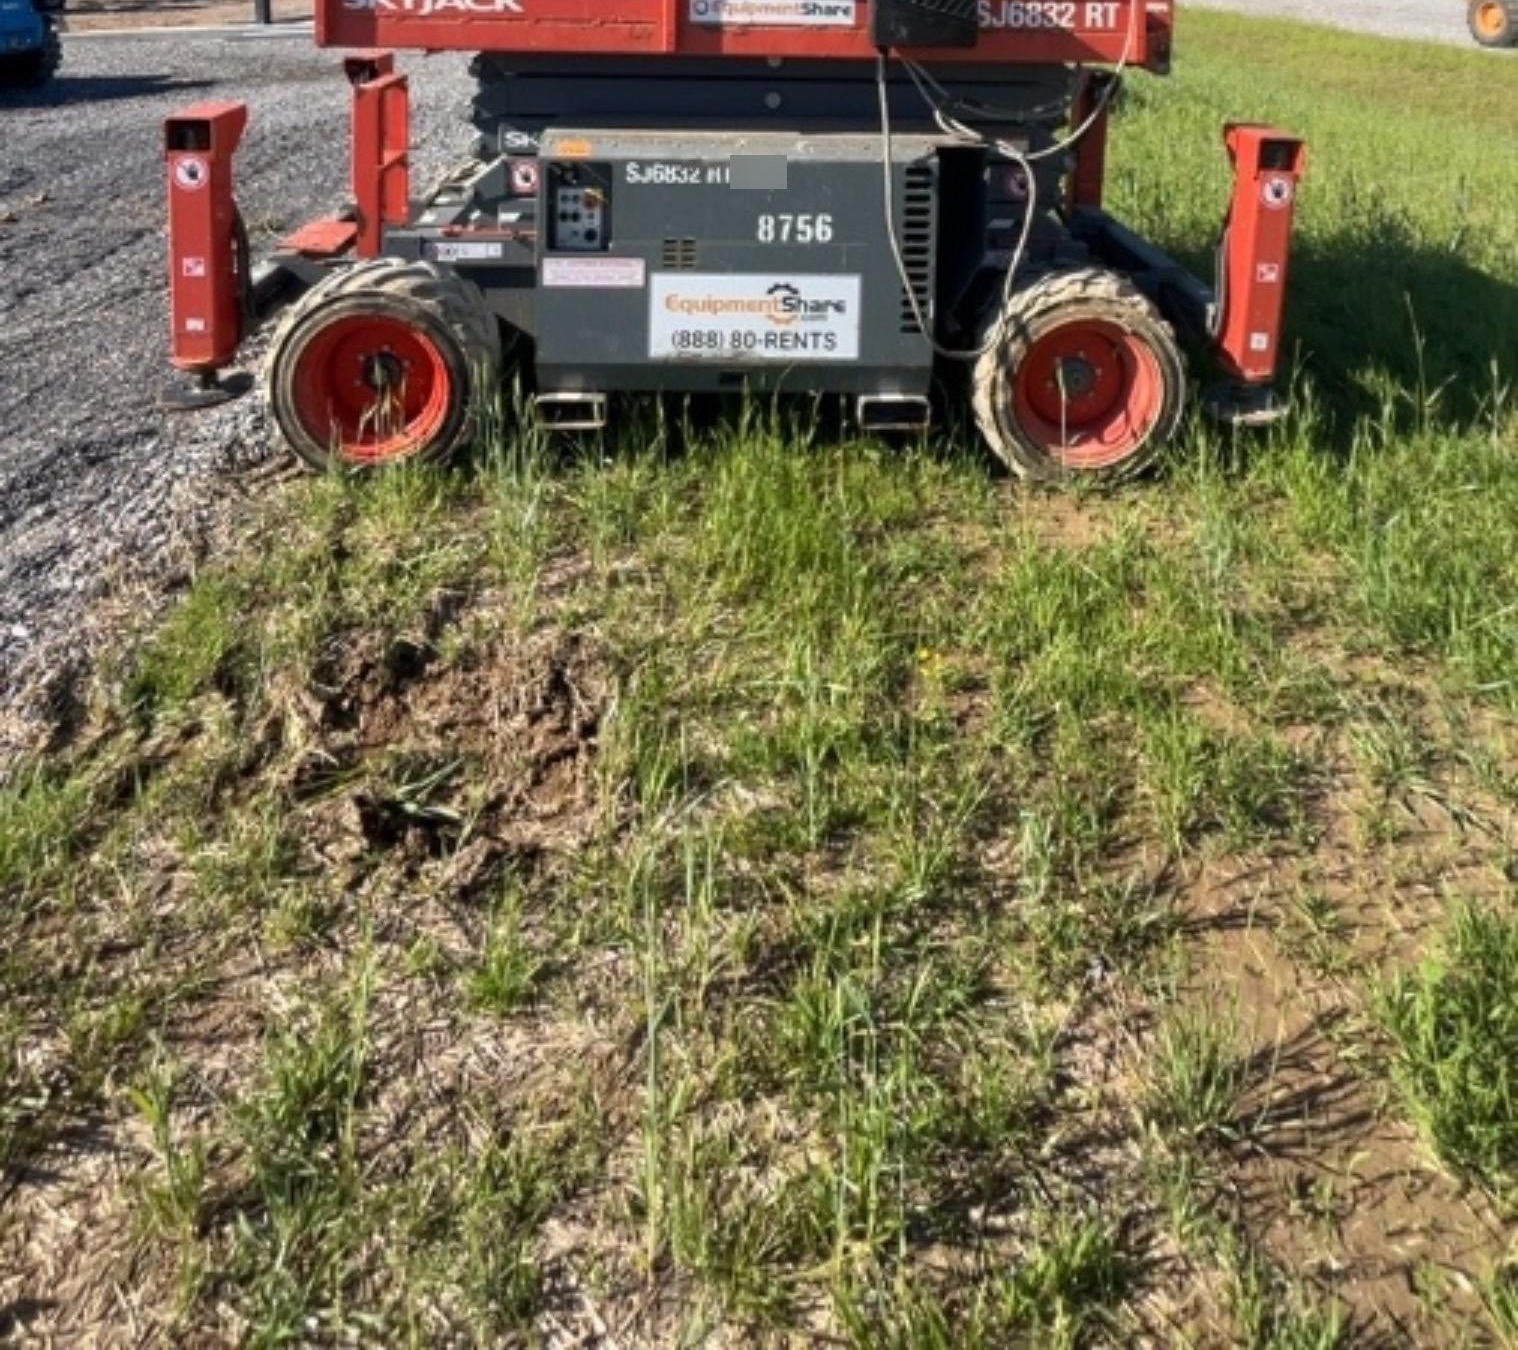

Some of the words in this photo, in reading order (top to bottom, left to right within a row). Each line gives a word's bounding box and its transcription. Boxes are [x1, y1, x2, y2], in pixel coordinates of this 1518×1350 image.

[713, 0, 851, 18] EquipmentShare
[977, 0, 1075, 28] SJ6832
[1085, 1, 1120, 28] RT
[757, 213, 833, 244] 8756
[665, 293, 846, 315] EquipmentShare
[671, 329, 724, 350] (888)
[730, 330, 838, 350] 80-RENTS
